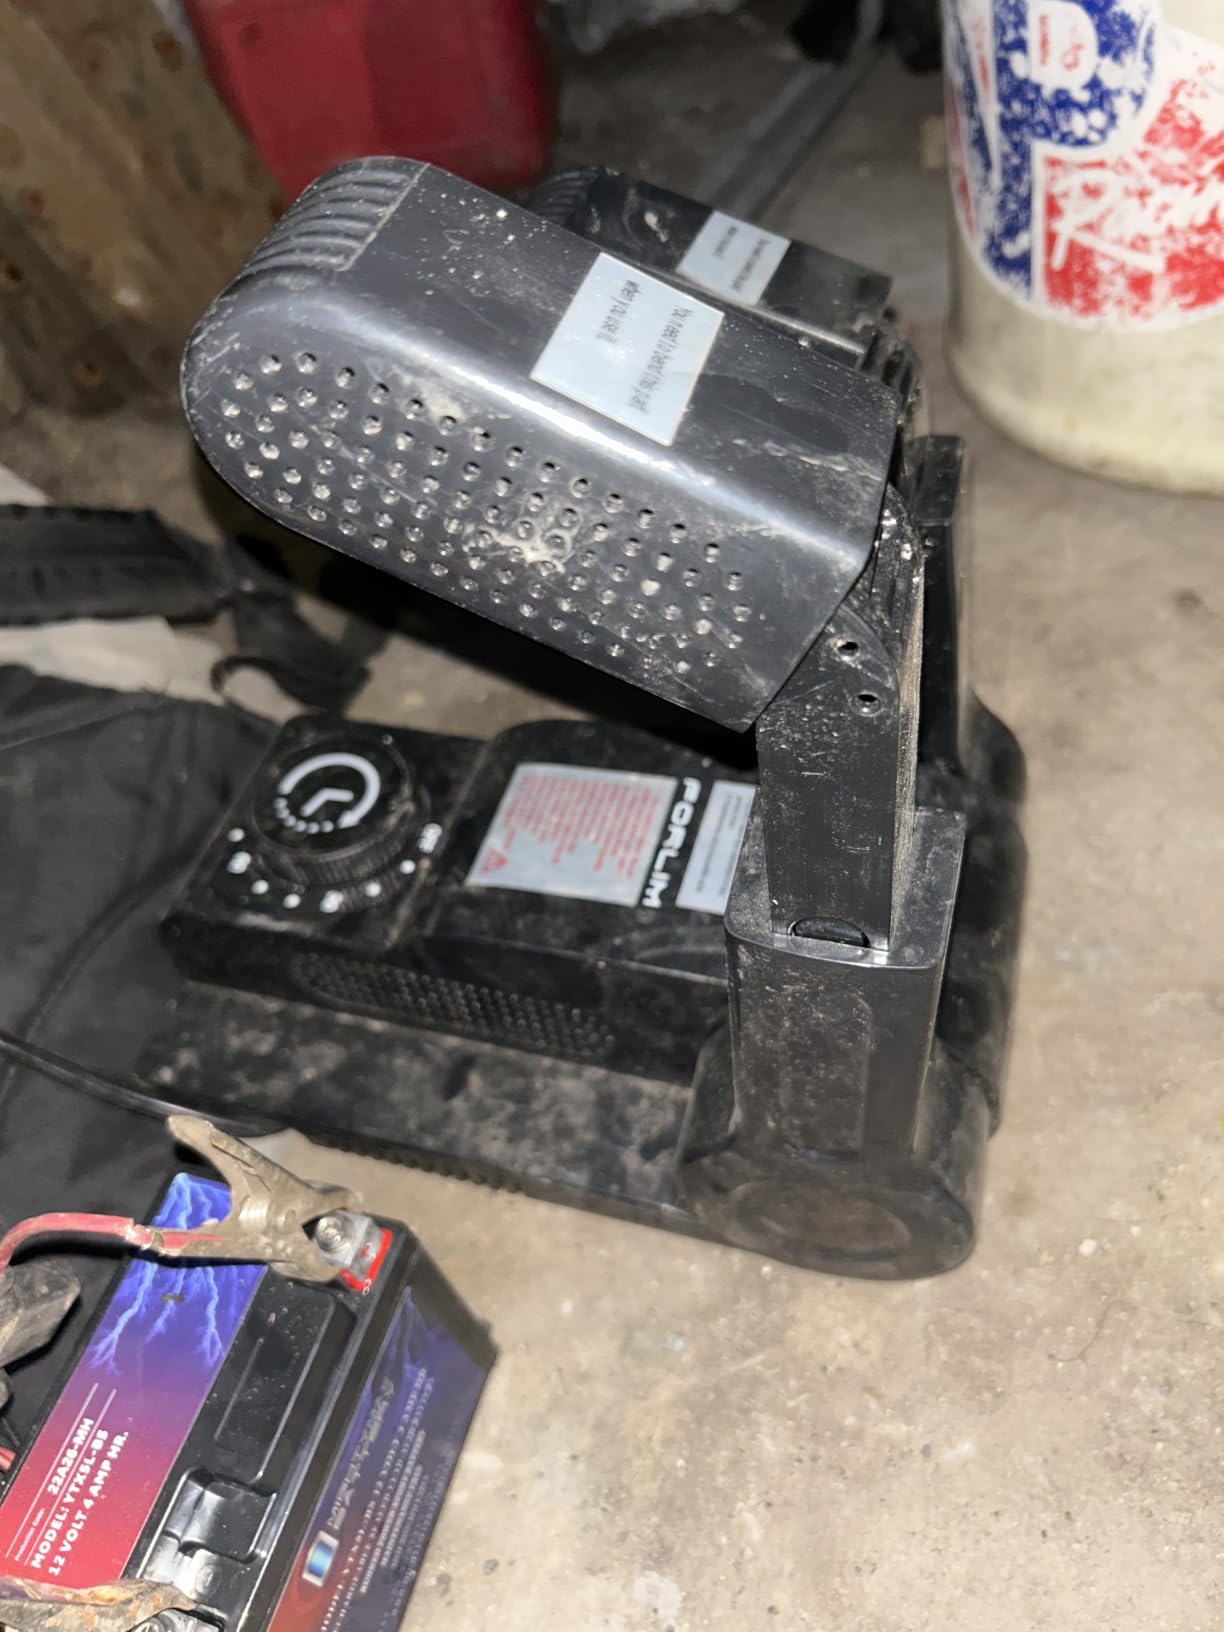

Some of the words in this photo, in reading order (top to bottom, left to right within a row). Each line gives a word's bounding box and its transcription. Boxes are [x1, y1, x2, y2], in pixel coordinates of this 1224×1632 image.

[662, 318, 685, 345] need
[642, 777, 701, 908] FORLIM
[31, 1506, 70, 1568] MODEL:
[63, 1430, 108, 1503] YTX5L-BS
[49, 1555, 65, 1575] 12
[60, 1510, 87, 1552] VOLT
[83, 1498, 94, 1509] 4
[89, 1459, 112, 1496] AMP
[106, 1431, 129, 1459] HR.
